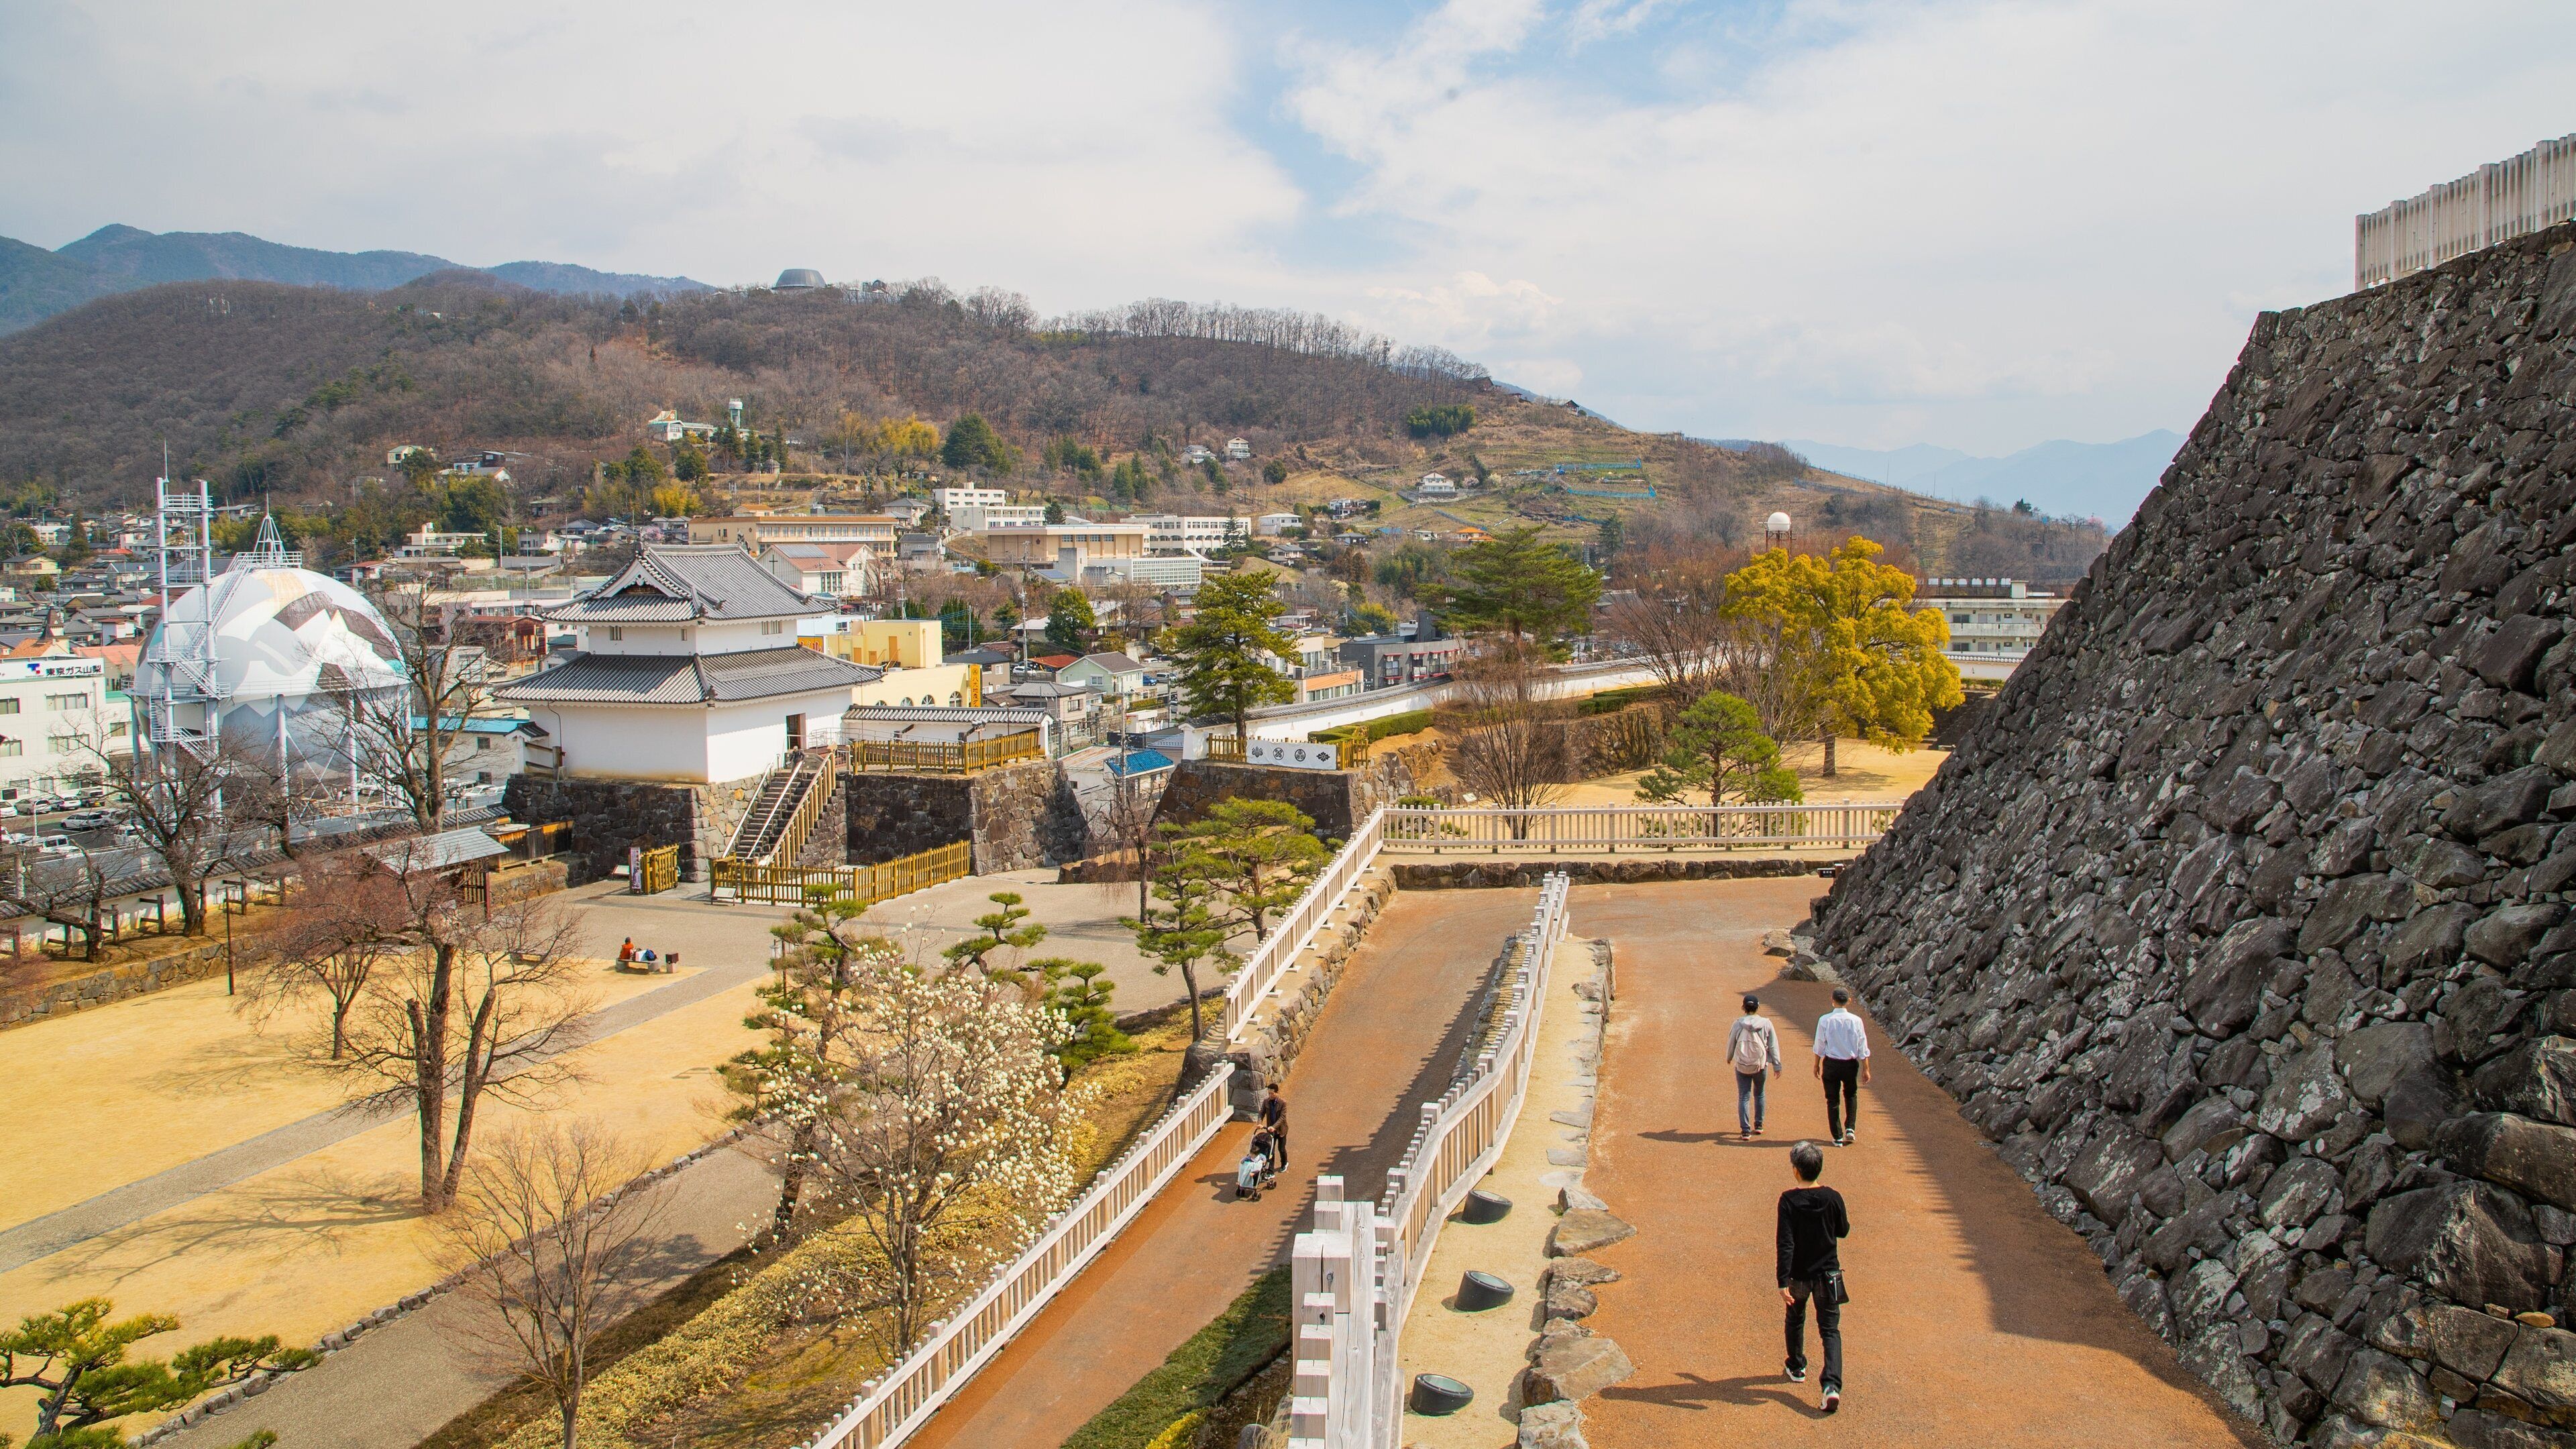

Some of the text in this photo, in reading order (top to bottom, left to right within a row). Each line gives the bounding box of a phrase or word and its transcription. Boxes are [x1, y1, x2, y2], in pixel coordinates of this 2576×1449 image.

[46, 665, 101, 676] 東京ガス山梨
